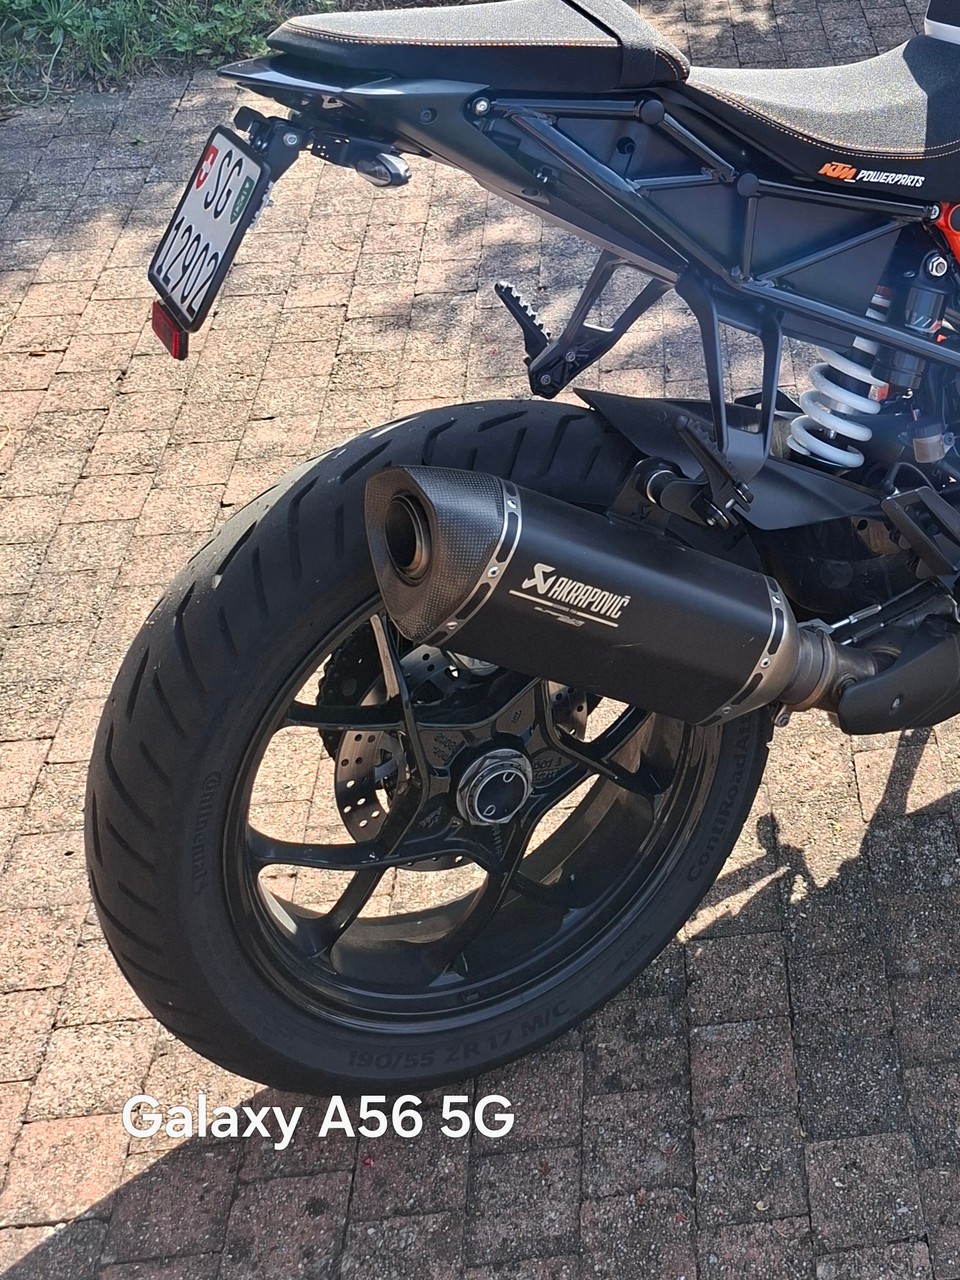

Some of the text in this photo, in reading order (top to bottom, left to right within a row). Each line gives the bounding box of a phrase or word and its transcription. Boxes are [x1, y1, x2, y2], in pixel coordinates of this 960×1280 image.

[203, 149, 244, 219] SG
[818, 161, 925, 187] KTM POWERPARTS
[154, 216, 220, 314] 12902
[547, 577, 632, 618] AKRAPOVIČ
[346, 999, 570, 1071] 190/55 ZR 17 M/C
